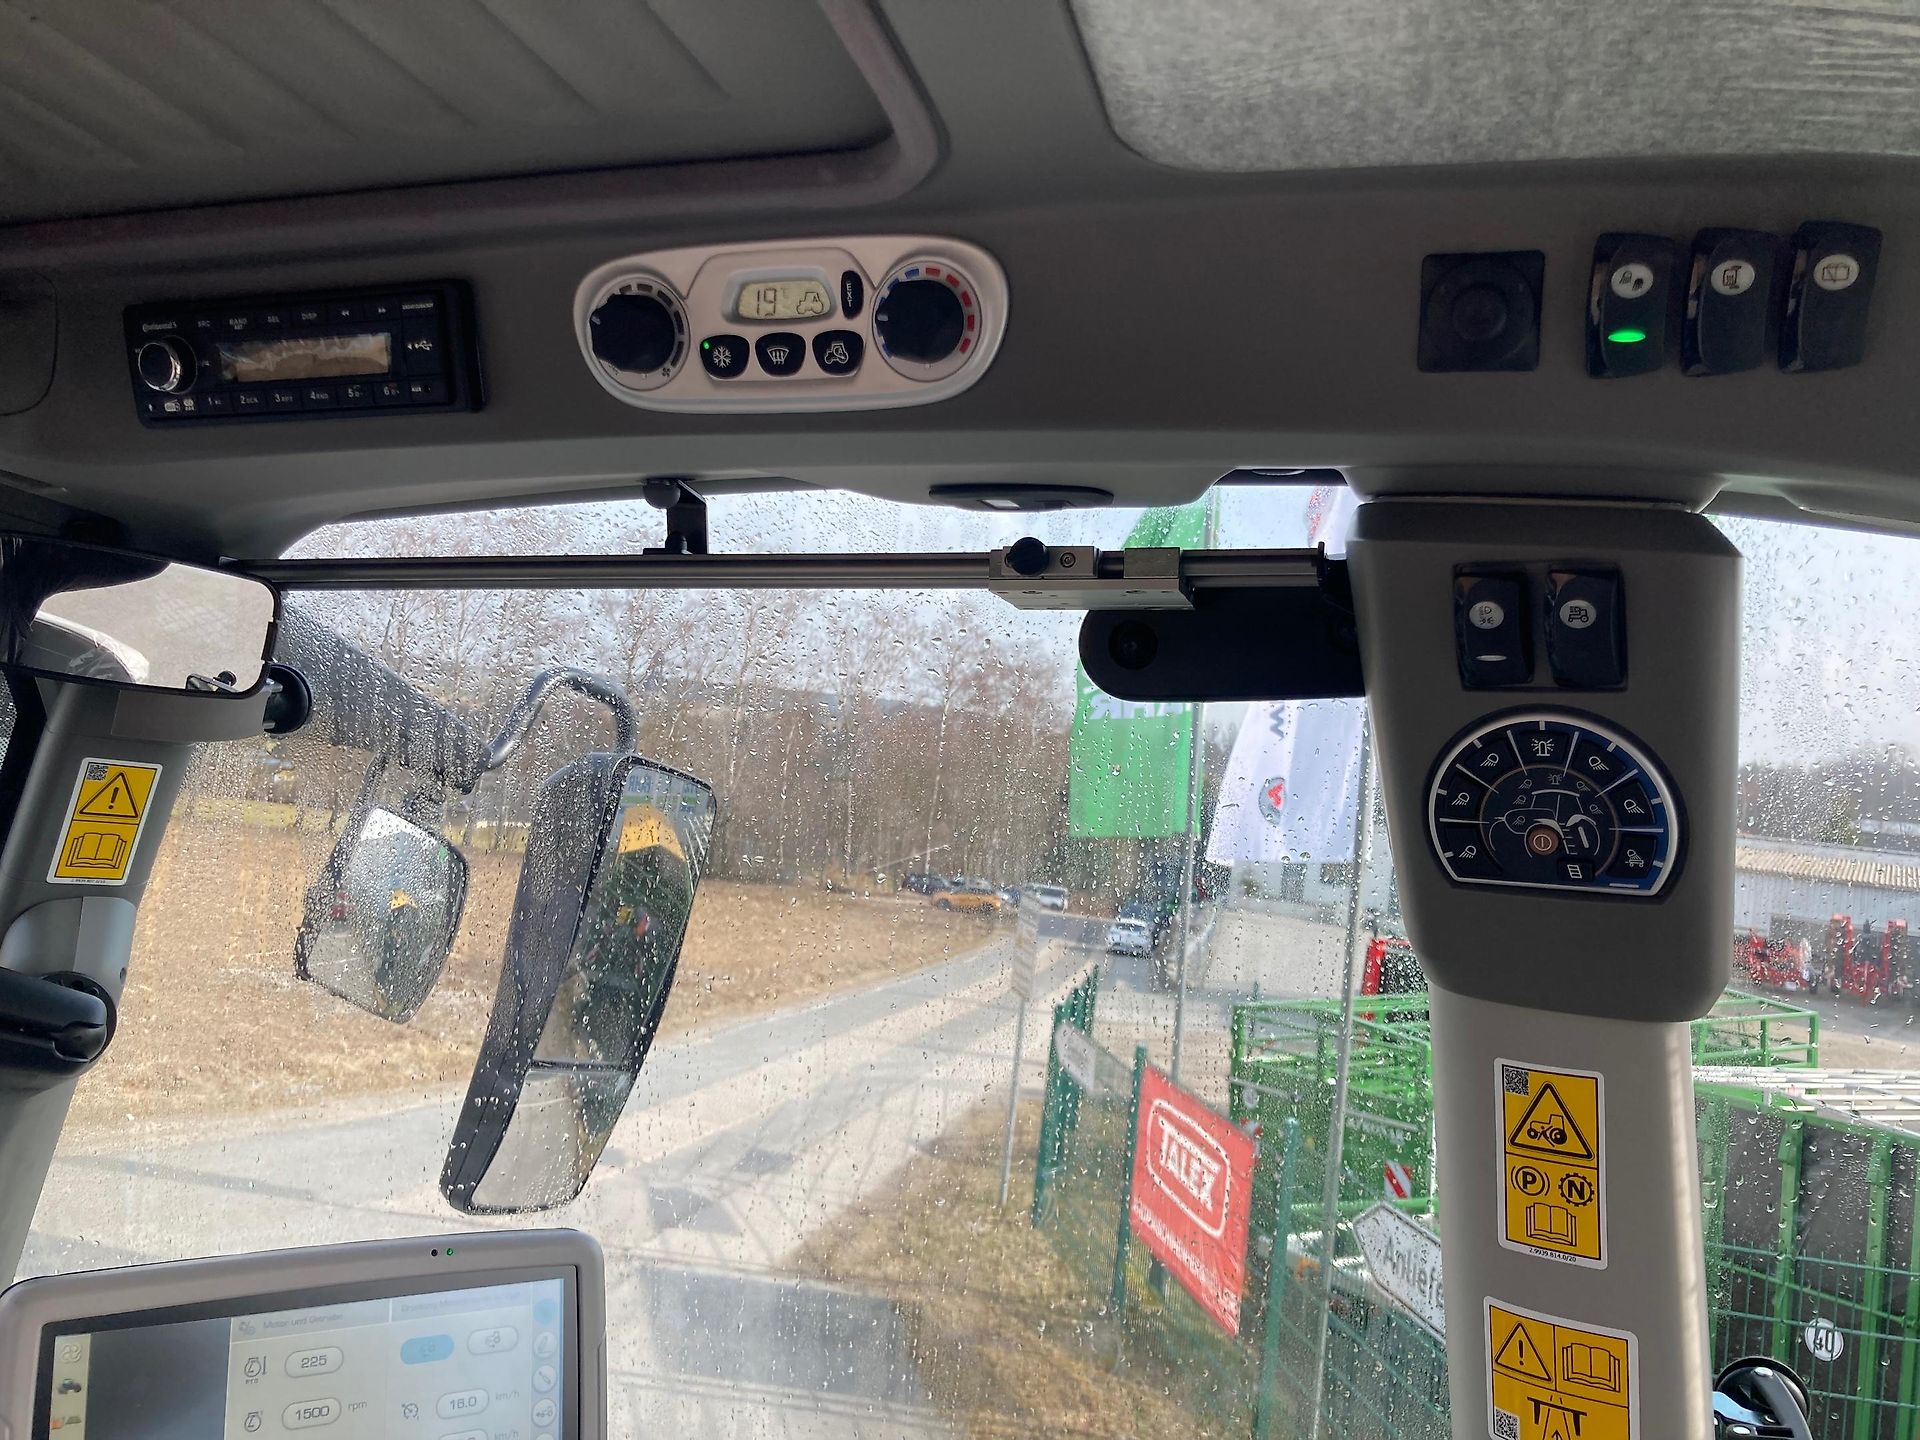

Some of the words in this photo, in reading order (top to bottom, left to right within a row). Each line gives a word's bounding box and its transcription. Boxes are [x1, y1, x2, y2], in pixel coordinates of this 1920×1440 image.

[757, 288, 777, 316] 19
[1156, 1114, 1222, 1214] TALEX
[1522, 1170, 1537, 1190] P
[1567, 1179, 1585, 1201] N
[301, 1354, 327, 1369] 225
[295, 1405, 330, 1421] 1500
[348, 1401, 368, 1413] rpm
